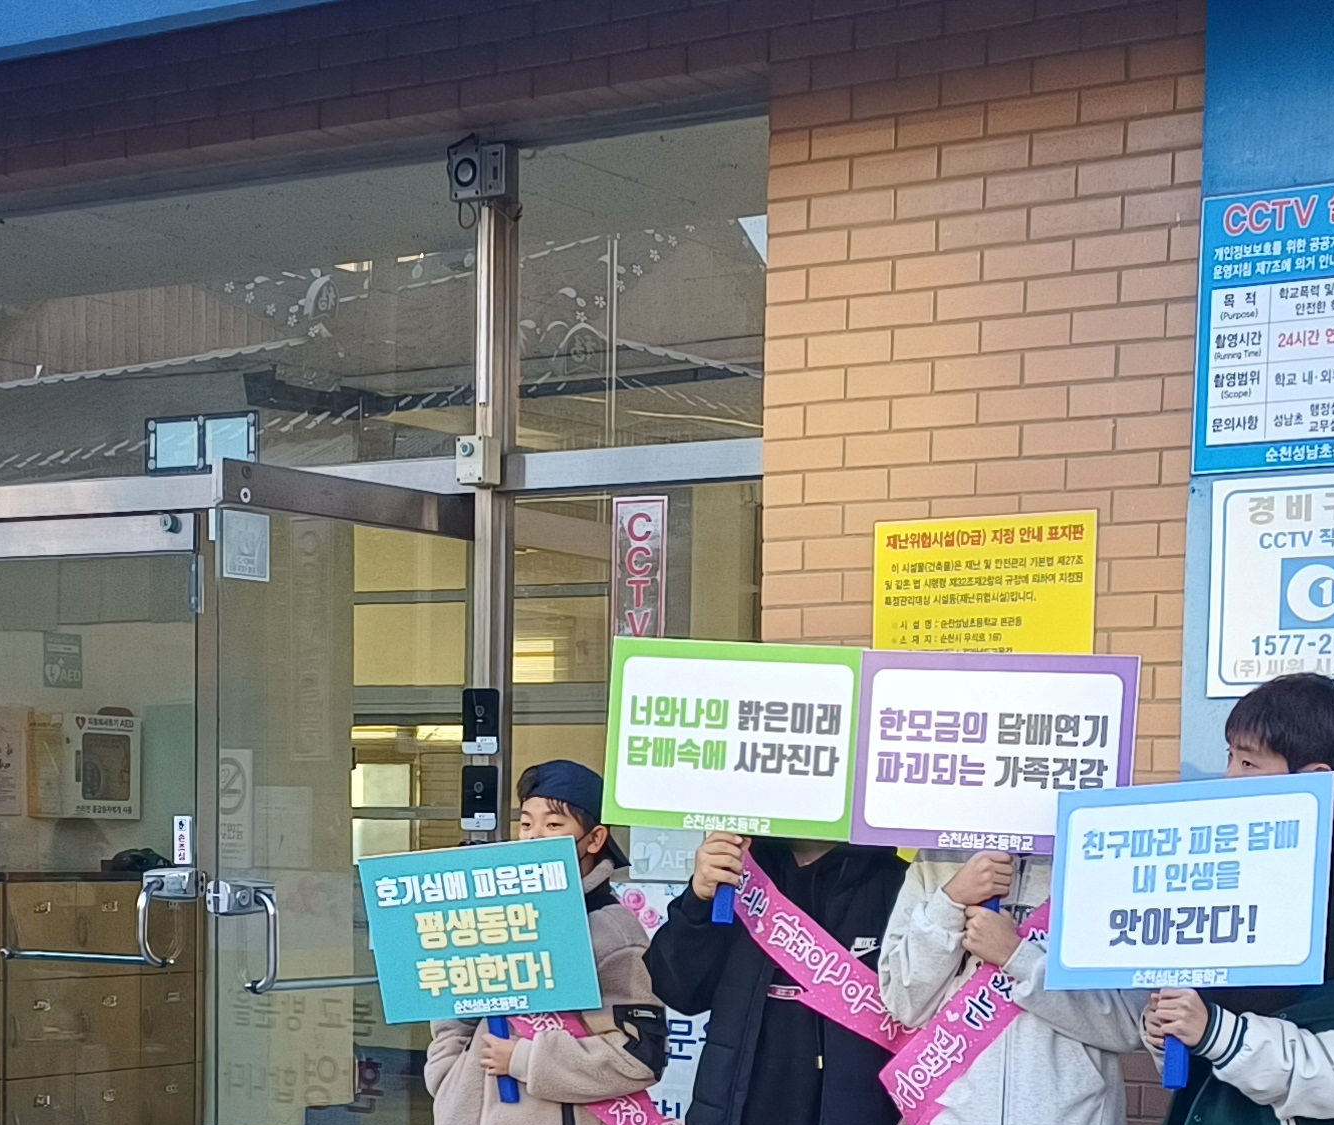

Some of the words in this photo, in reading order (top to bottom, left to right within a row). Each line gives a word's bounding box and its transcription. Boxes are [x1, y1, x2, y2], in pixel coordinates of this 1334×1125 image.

[1224, 196, 1318, 236] CCTV
[1213, 241, 1283, 260] 개인정보보호를
[1286, 236, 1307, 254] 위한
[1279, 285, 1320, 299] 학교폭력
[1324, 283, 1334, 297] 및
[1220, 307, 1258, 321] (Purpose)
[1295, 300, 1326, 316] 안전한
[1215, 331, 1262, 349] 촬영시간
[1277, 328, 1320, 348] 24시간
[1213, 369, 1260, 388] 촬영범위
[1275, 371, 1297, 387] 학교
[1220, 387, 1252, 400] (Scope)
[1212, 414, 1259, 432] 문의사항
[1273, 413, 1304, 427] 성남초
[885, 529, 986, 550] 재난위험시설(D급)
[991, 527, 1015, 545] 지정
[1019, 526, 1043, 544] 안내
[1047, 523, 1085, 541] 표지판
[1259, 530, 1313, 549] CCTV
[626, 511, 653, 638] CCTV
[60, 669, 81, 681] AED
[1233, 659, 1261, 678] (주)
[120, 718, 134, 728] AED
[628, 692, 729, 731] 너와나의
[737, 700, 842, 737] 밝은미래
[877, 706, 988, 746] 한모금의
[996, 712, 1109, 749] 담배연기
[626, 734, 727, 773] 담배속에
[733, 742, 840, 779] 사라진다
[875, 750, 988, 789] 파괴되는
[993, 756, 1109, 791] 가족건강
[682, 813, 771, 834] 순천성남초등학교
[937, 831, 1035, 853] 순천성남초등학교
[1082, 827, 1182, 861] 친구따라
[1188, 823, 1239, 855] 피운
[1247, 819, 1301, 852] 담배
[374, 869, 468, 908] 호기심에
[471, 859, 569, 899] 피운담배
[1132, 864, 1157, 894] 내
[1165, 860, 1241, 893] 인생을
[414, 902, 540, 950] 평생동안
[855, 937, 878, 948] NIKE
[416, 950, 555, 997] 후회한다!
[1131, 968, 1228, 988] 순천성남초등학교
[453, 995, 529, 1015] 순천성남초등학교
